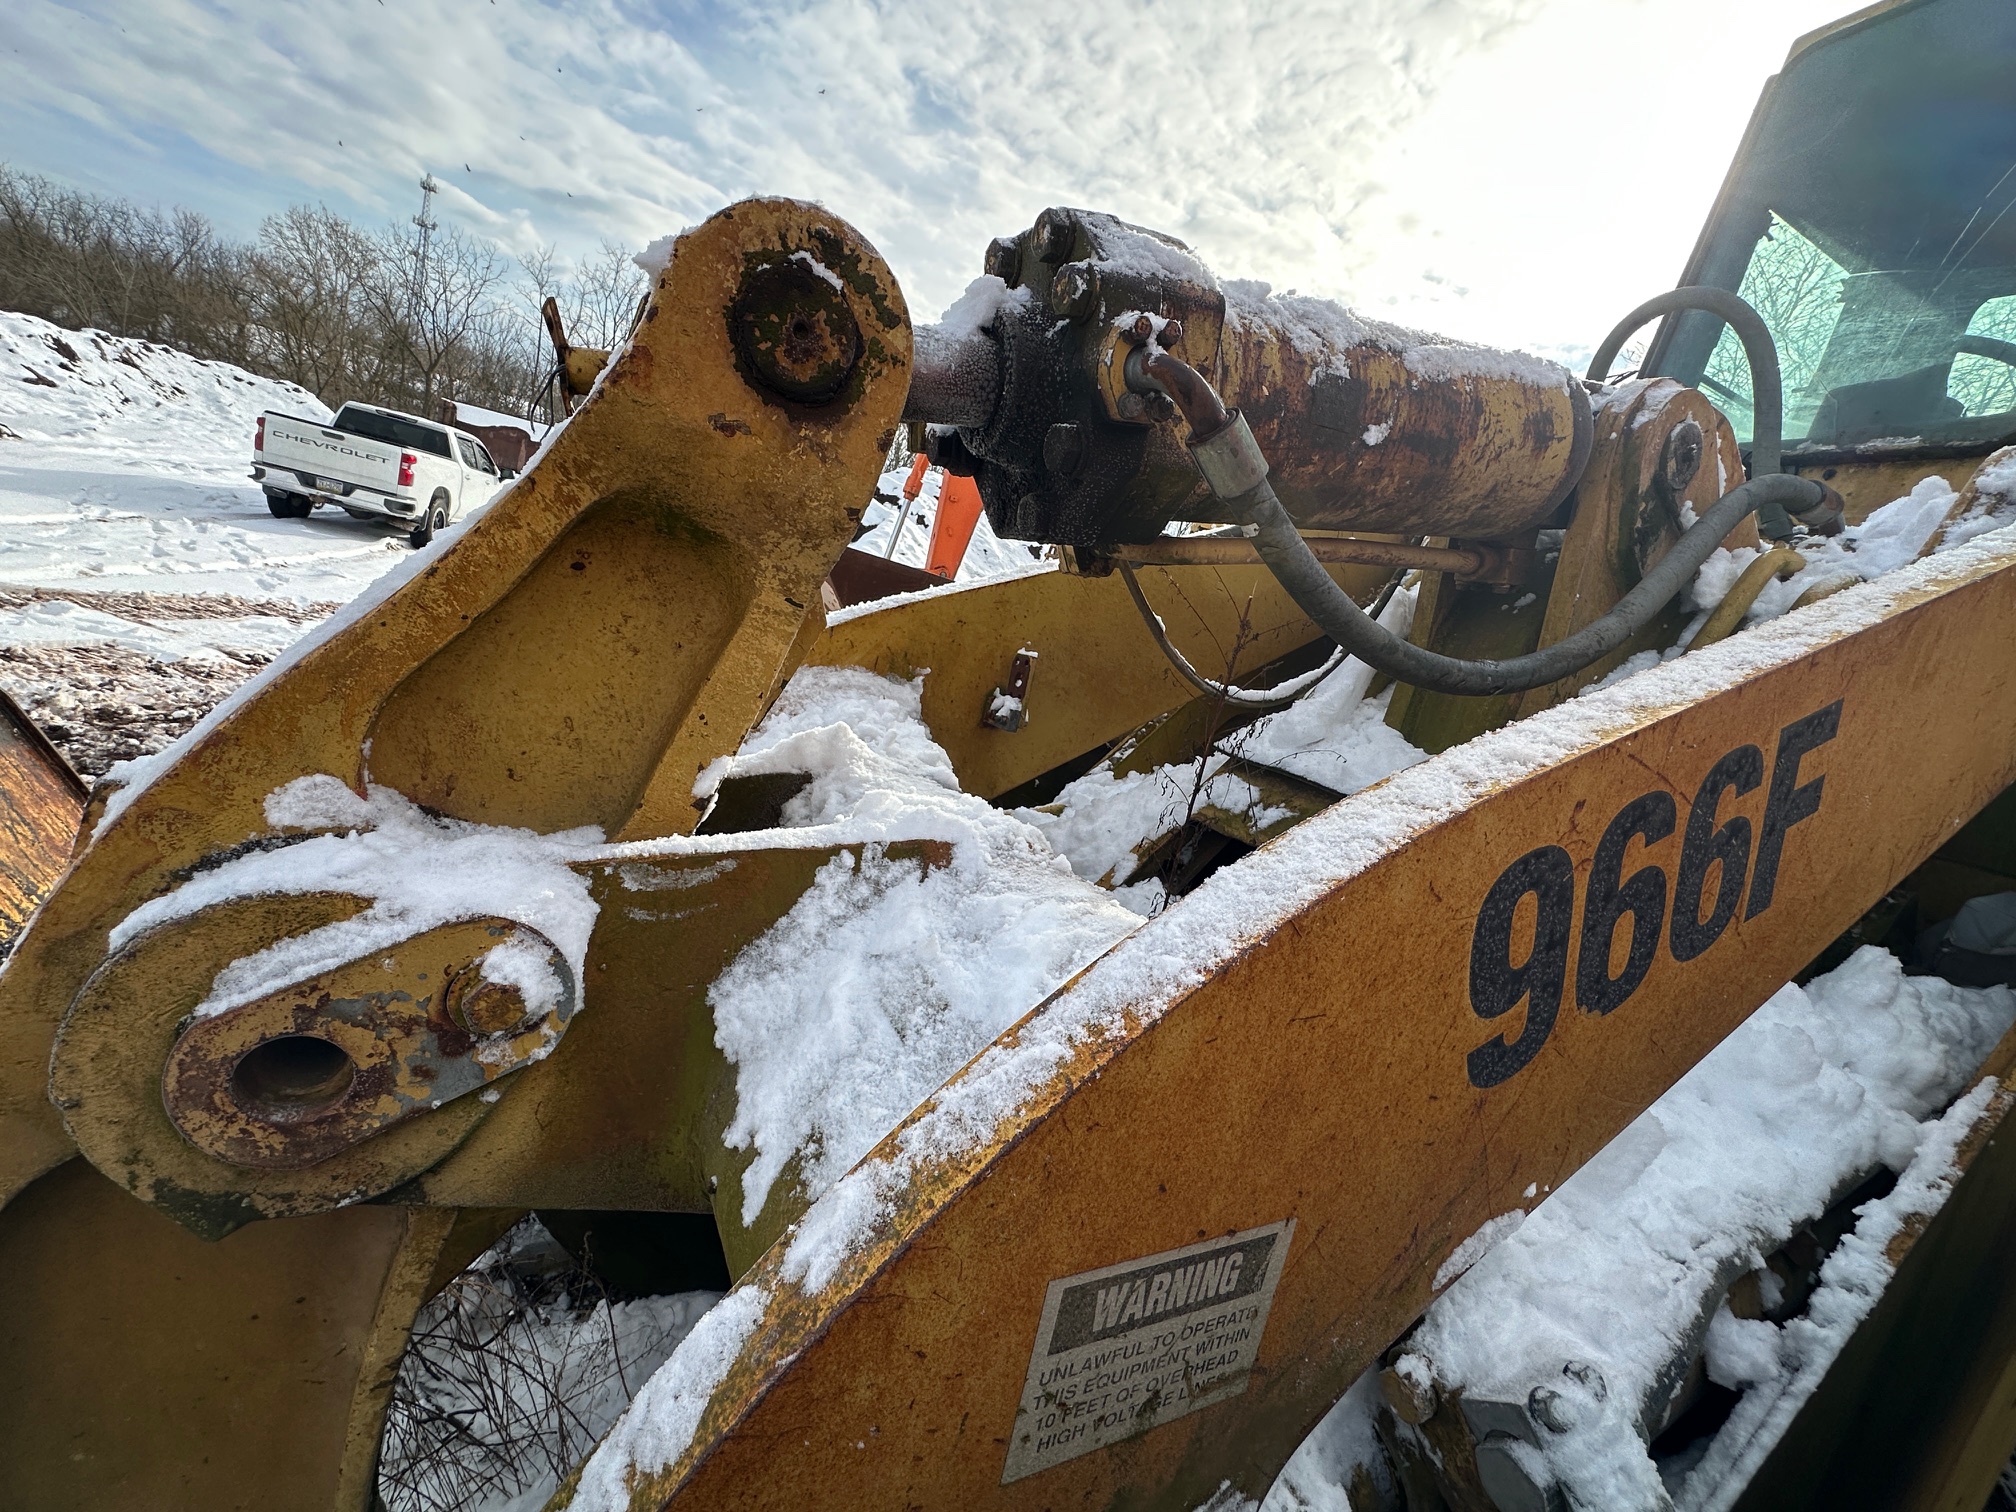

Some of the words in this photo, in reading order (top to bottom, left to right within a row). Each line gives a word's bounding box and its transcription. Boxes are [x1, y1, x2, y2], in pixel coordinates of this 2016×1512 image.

[272, 430, 390, 464] CHEVROLET
[1466, 697, 1845, 1090] 966F
[1092, 1252, 1244, 1332] WARNING
[1034, 1384, 1078, 1411] THIS
[1083, 1346, 1192, 1395] EQUIPMENT
[1196, 1328, 1251, 1356] WITHIN
[1040, 1341, 1146, 1387] UNLAWFUL
[1153, 1331, 1176, 1351] TO
[1036, 1412, 1056, 1432] 10
[1061, 1393, 1112, 1423] FEET
[1116, 1382, 1143, 1402] OF
[1036, 1422, 1086, 1453] HIGH
